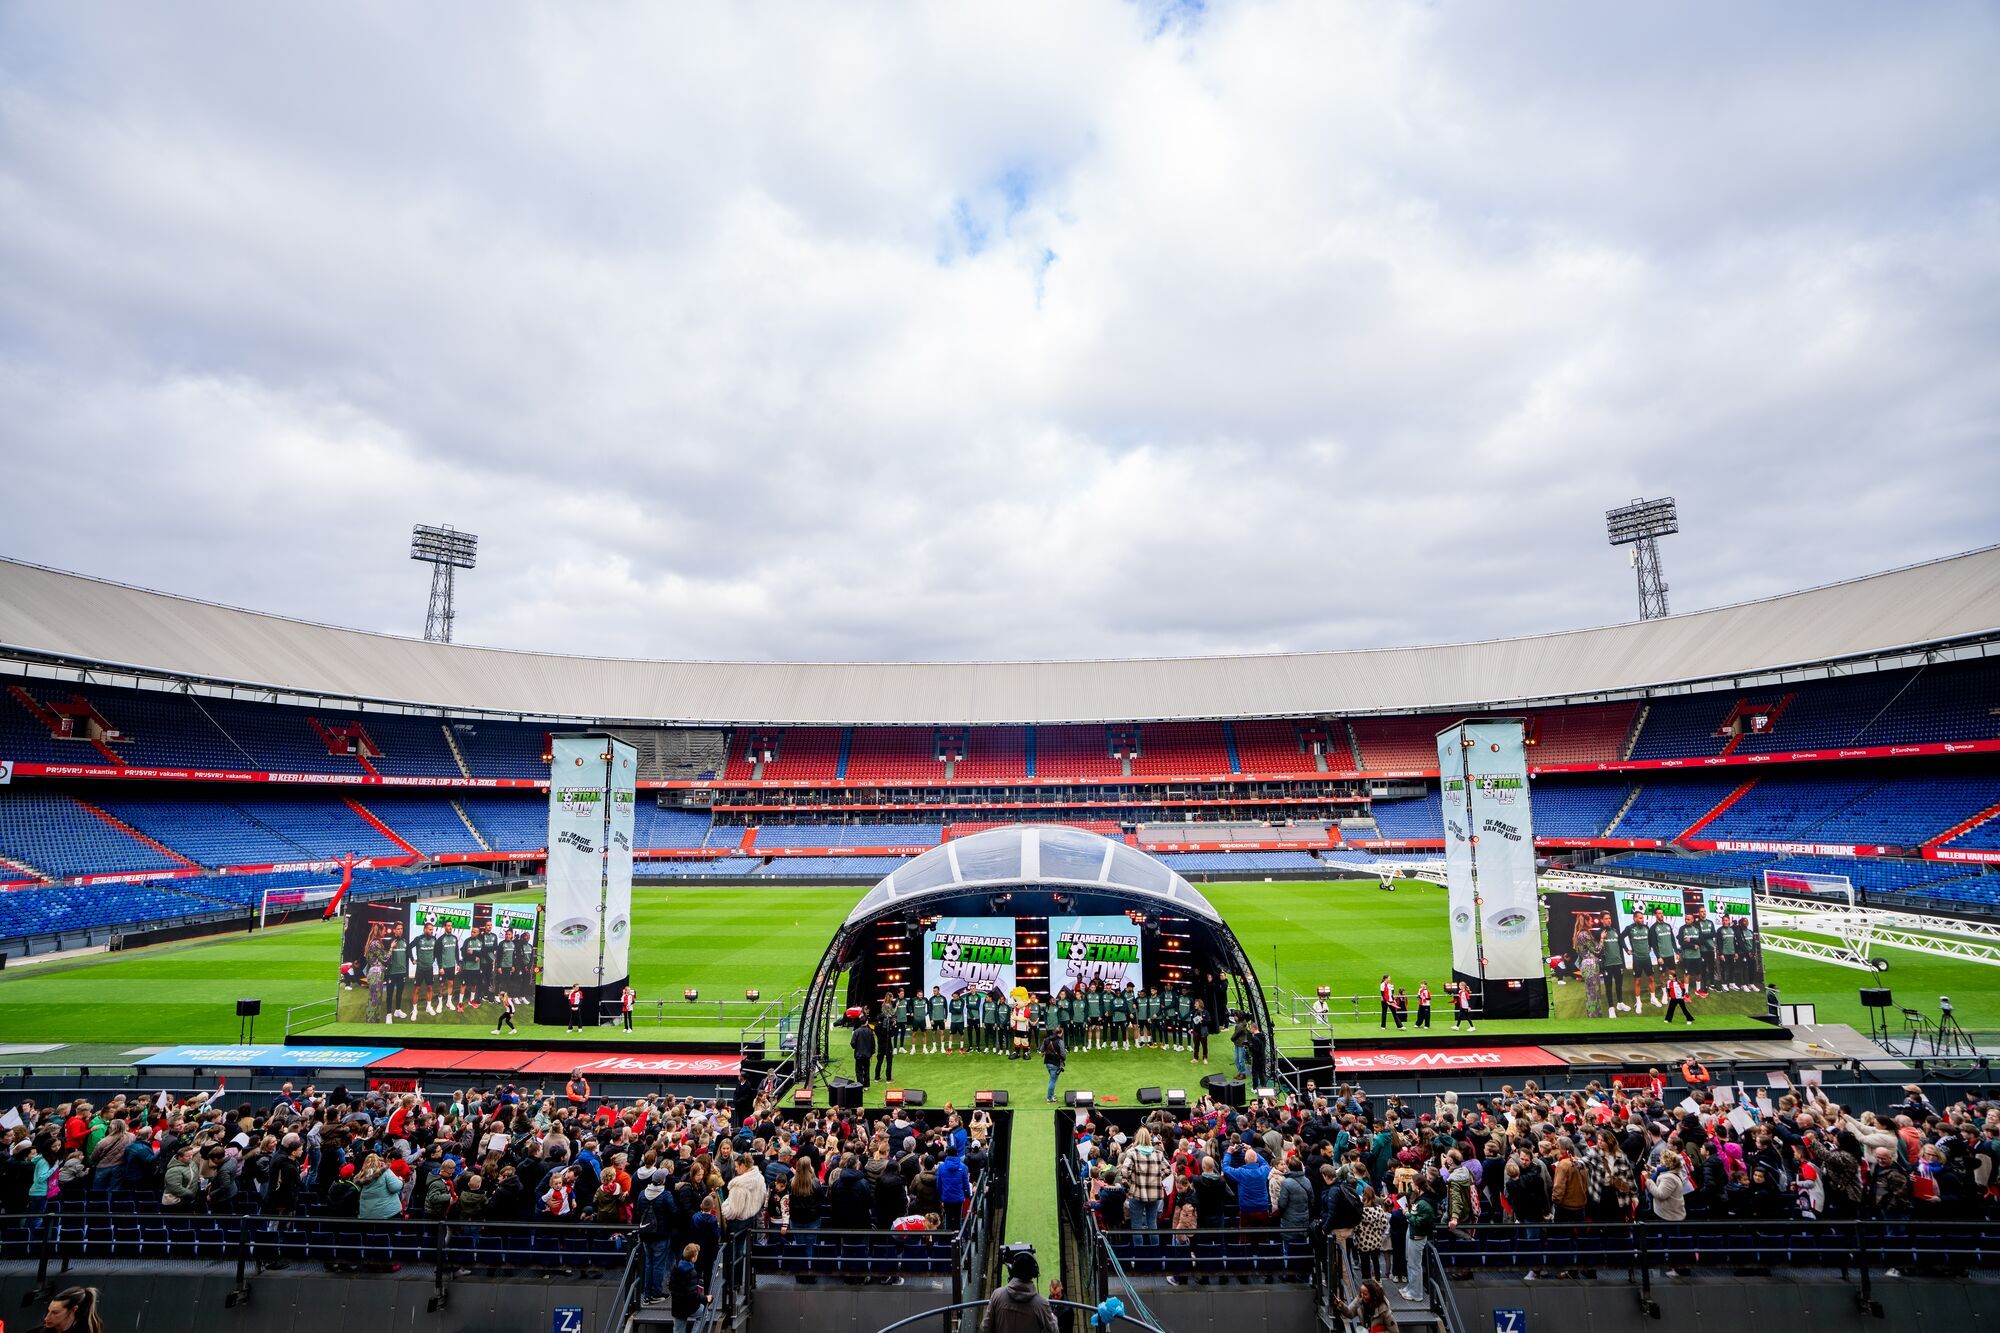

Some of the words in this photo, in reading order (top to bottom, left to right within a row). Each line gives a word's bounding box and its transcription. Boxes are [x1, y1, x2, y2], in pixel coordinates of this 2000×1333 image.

[277, 774, 299, 782] KEER
[299, 774, 362, 784] LANDSKAMPIOEN
[382, 776, 418, 786] WINNAAR
[418, 778, 436, 786] UEFA
[437, 778, 450, 786] CUP
[1483, 788, 1516, 800] SHOW
[562, 802, 594, 812] SHOW
[1494, 820, 1518, 834] MAGIE
[569, 832, 592, 846] MAGIE
[1504, 832, 1522, 842] KUIP
[576, 844, 594, 854] KUIP
[1716, 842, 1750, 851] WILLEM
[1750, 843, 1769, 852] VAN
[1769, 844, 1814, 854] HANEGEM
[1814, 844, 1856, 856] TRIBUNE
[1966, 852, 1983, 860] VAN
[1624, 892, 1633, 900] DE
[1633, 893, 1680, 904] KAMERAADJES
[428, 906, 472, 916] KAMERAADJES
[936, 934, 947, 942] DE
[947, 934, 1011, 946] KAMERAADJES
[1060, 933, 1072, 942] DE
[1072, 934, 1136, 946] KAMERAADJES
[940, 960, 1002, 982] SHOW
[1066, 959, 1128, 982] SHOW
[577, 1058, 689, 1070] Media
[1334, 1056, 1374, 1067] dia
[1409, 1053, 1501, 1066] Markt
[561, 1312, 574, 1332] Z
[1504, 1314, 1518, 1333] Z
